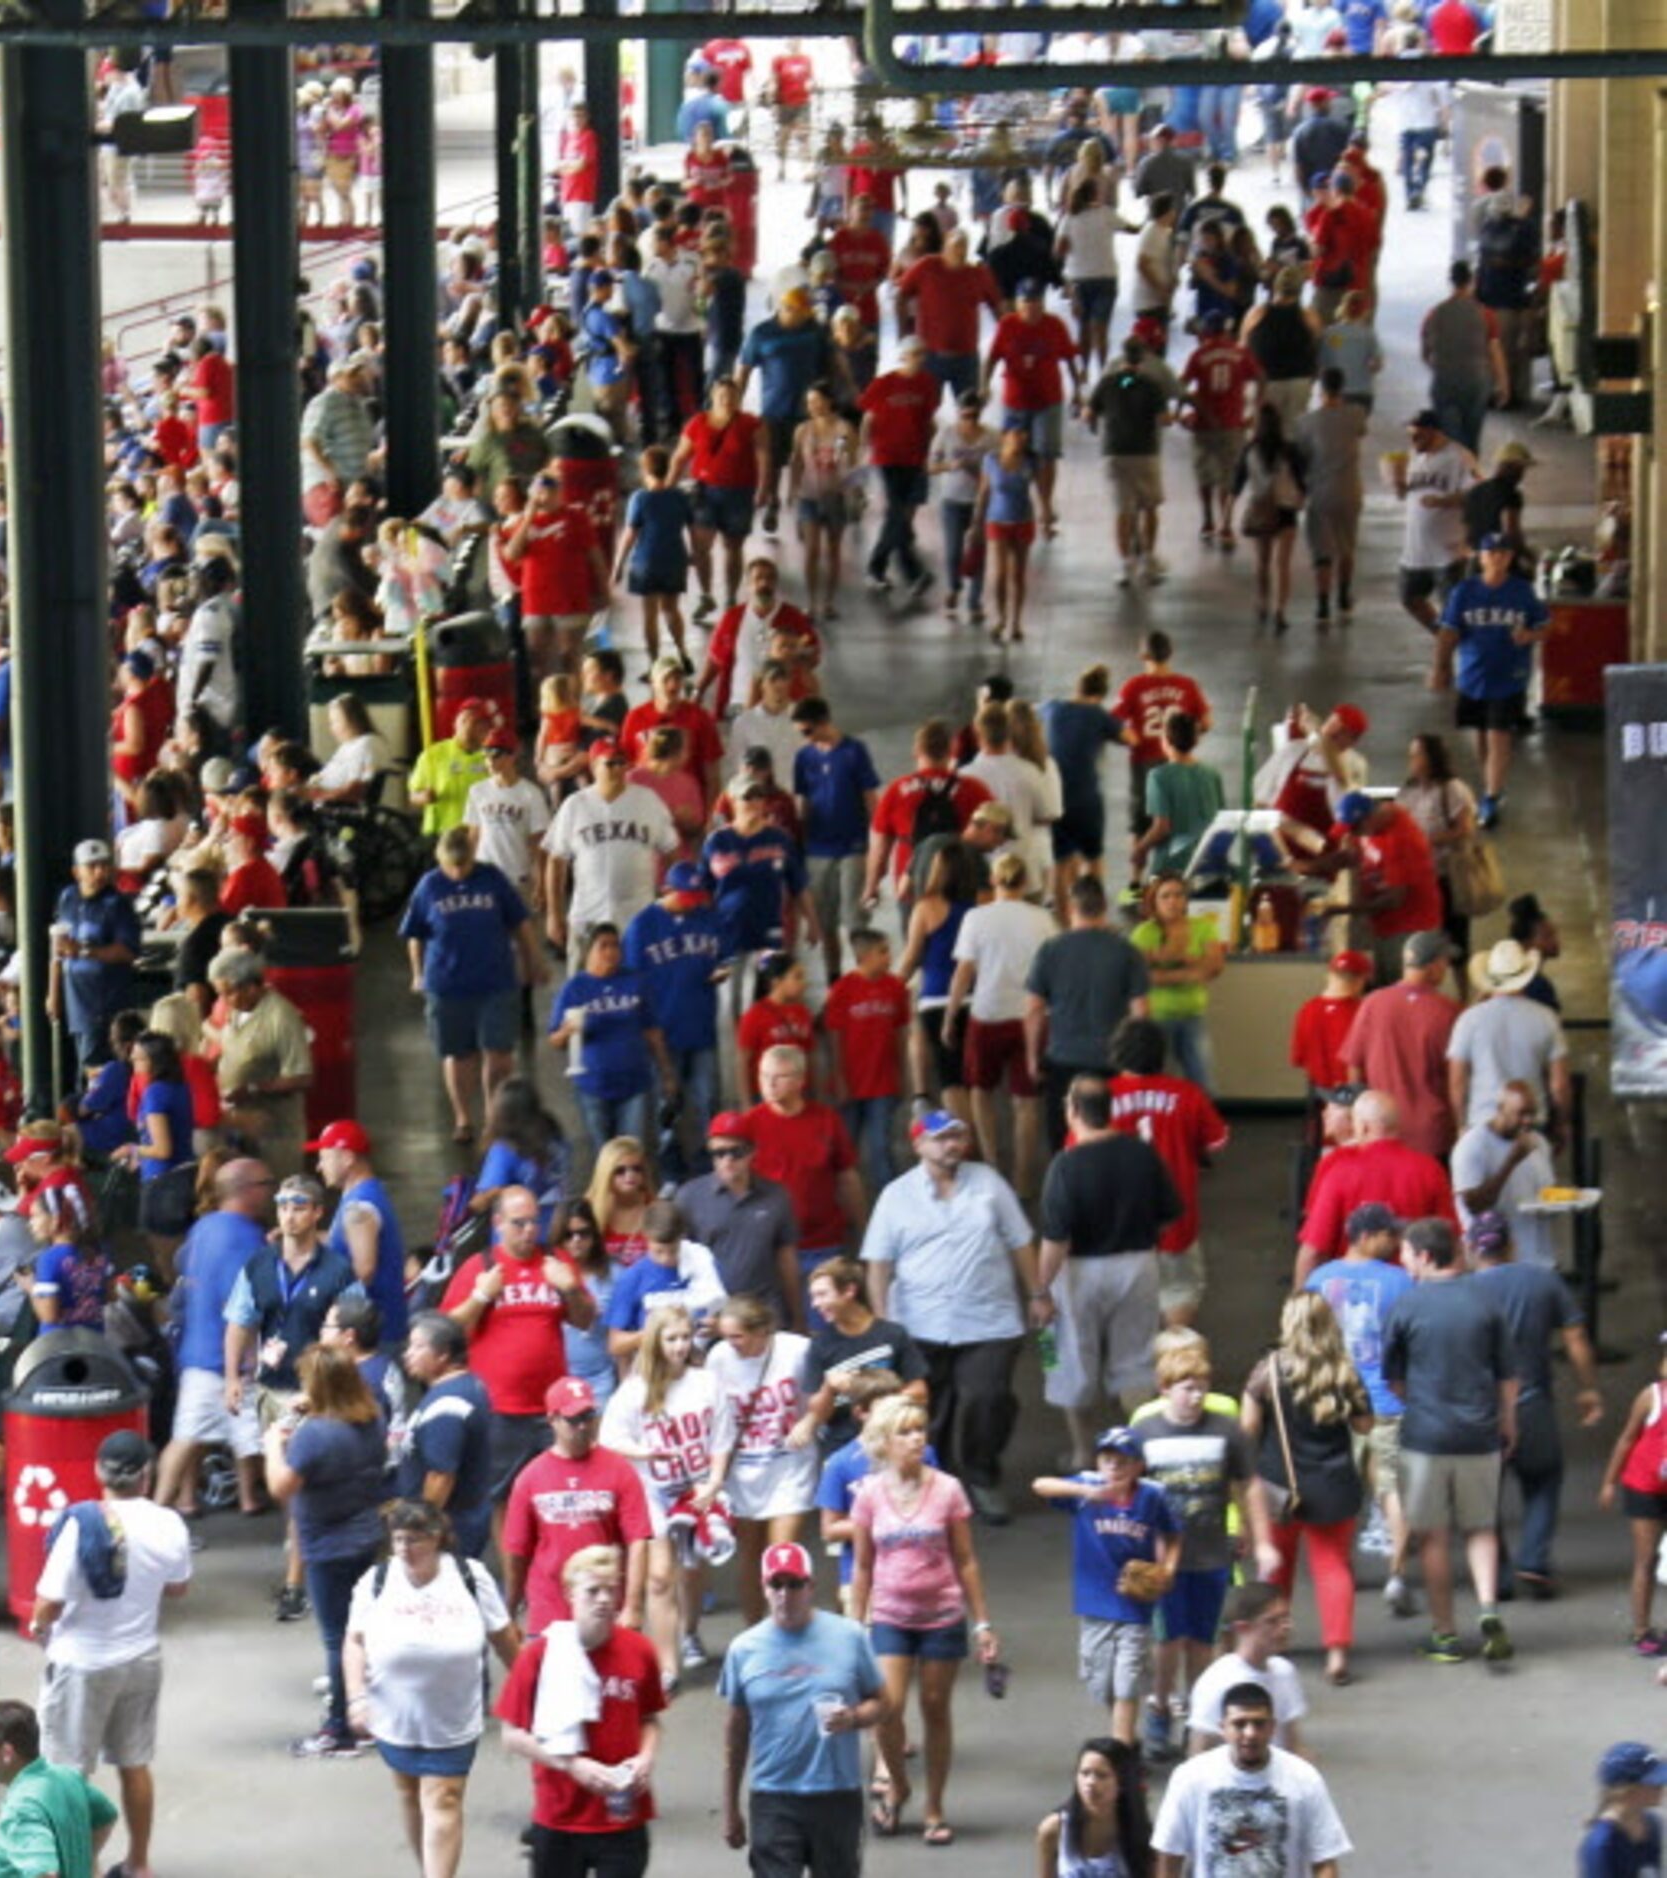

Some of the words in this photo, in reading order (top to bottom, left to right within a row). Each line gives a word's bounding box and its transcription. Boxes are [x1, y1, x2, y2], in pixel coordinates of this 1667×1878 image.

[578, 820, 650, 846] TEXAS
[438, 893, 495, 915] TEXAS
[646, 932, 718, 964] TEXAS
